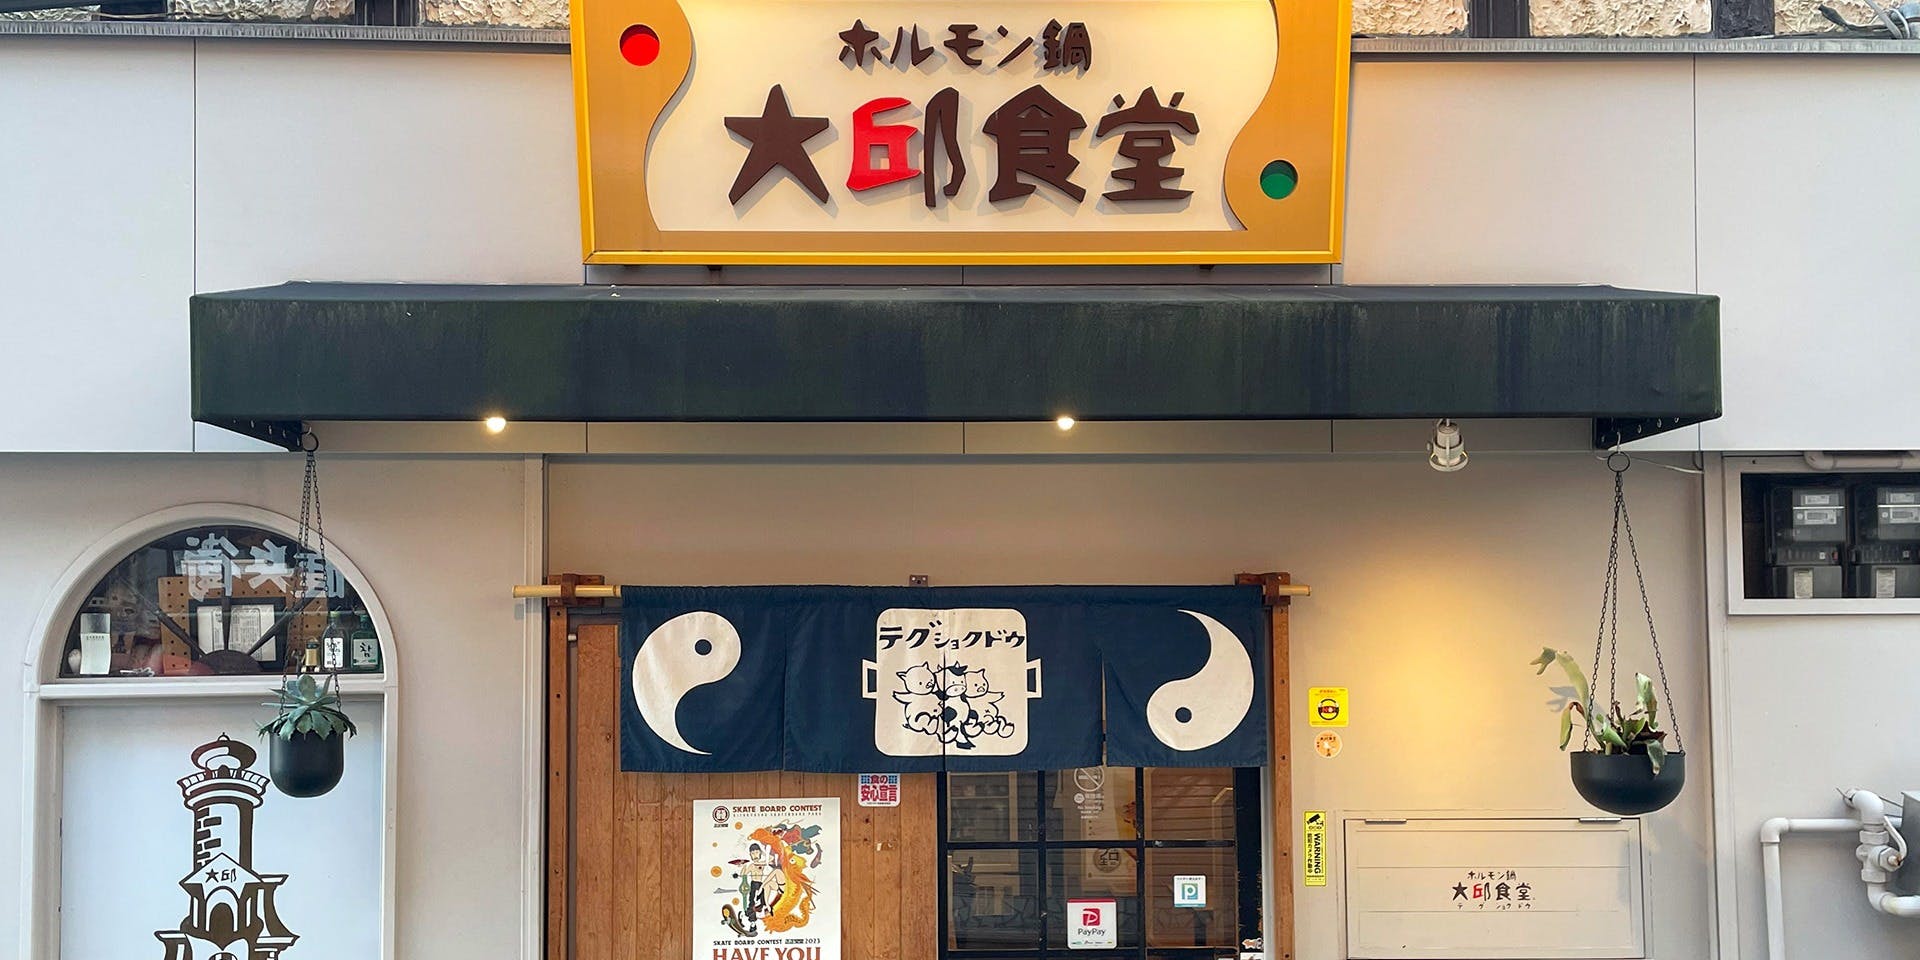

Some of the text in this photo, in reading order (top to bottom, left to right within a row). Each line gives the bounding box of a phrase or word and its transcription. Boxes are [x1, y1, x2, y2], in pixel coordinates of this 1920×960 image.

[838, 19, 1092, 71] ホルモン鍋
[724, 84, 1200, 207] 大邱食堂
[879, 620, 1025, 650] テグショクドウ
[871, 774, 888, 784] 食の
[861, 785, 898, 802] 安心宣言
[789, 804, 822, 812] CONTEST
[1314, 832, 1322, 874] WARNING
[205, 868, 237, 884] 大邱
[1467, 870, 1517, 881] ホルモン鍋
[1452, 881, 1532, 902] 大邱食堂
[1077, 928, 1107, 936] PayPay
[712, 946, 821, 960] HAVE YOU
